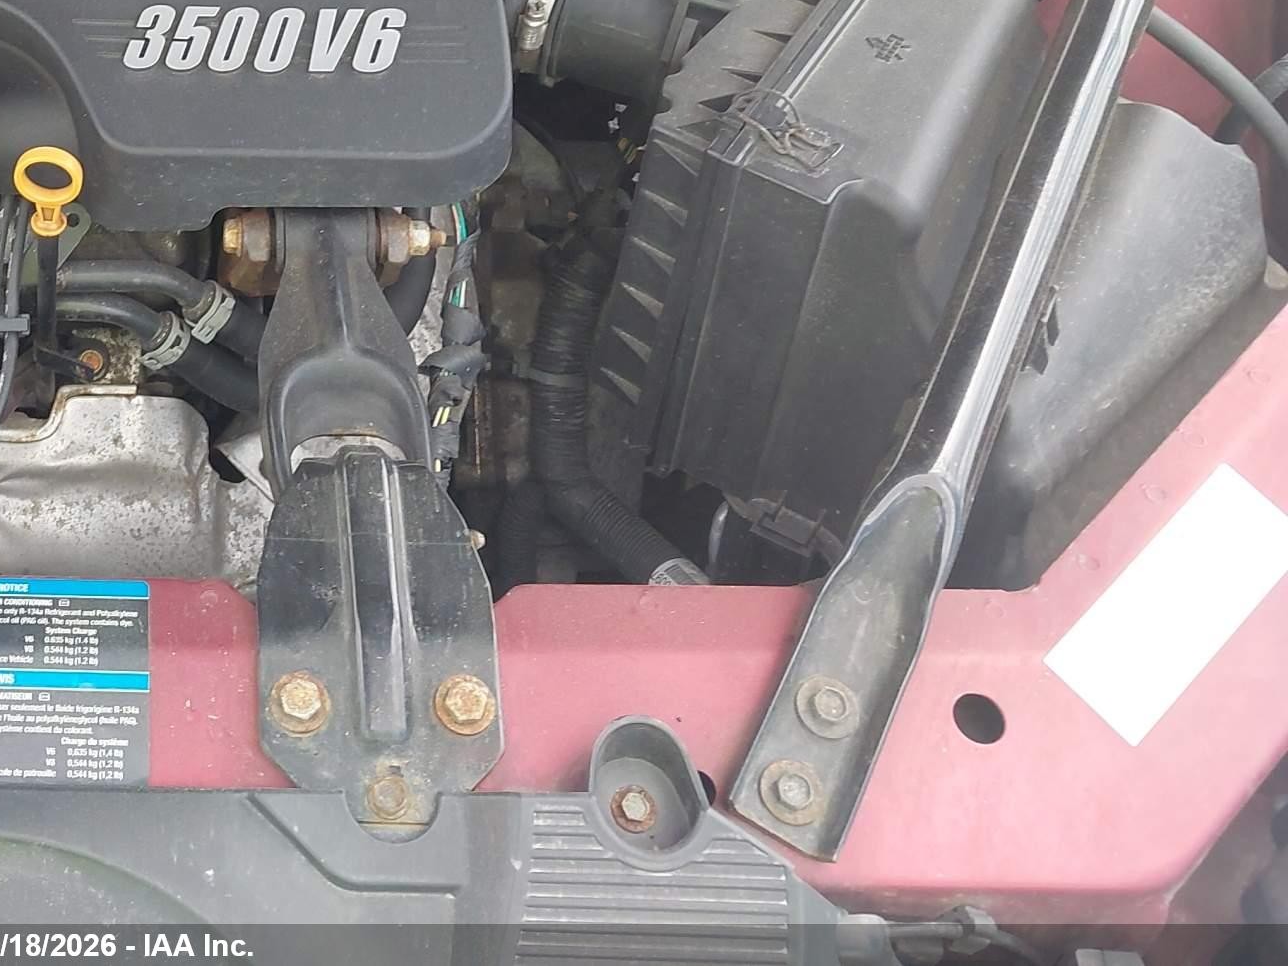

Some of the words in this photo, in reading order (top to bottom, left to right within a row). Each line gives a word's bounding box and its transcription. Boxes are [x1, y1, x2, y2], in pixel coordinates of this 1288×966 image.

[123, 4, 306, 73] 3500
[308, 8, 407, 73] V6
[72, 628, 97, 636] Charge
[64, 637, 73, 645] kg
[74, 637, 88, 645] (1.4
[64, 656, 73, 665] kg
[74, 657, 88, 665] (1.2
